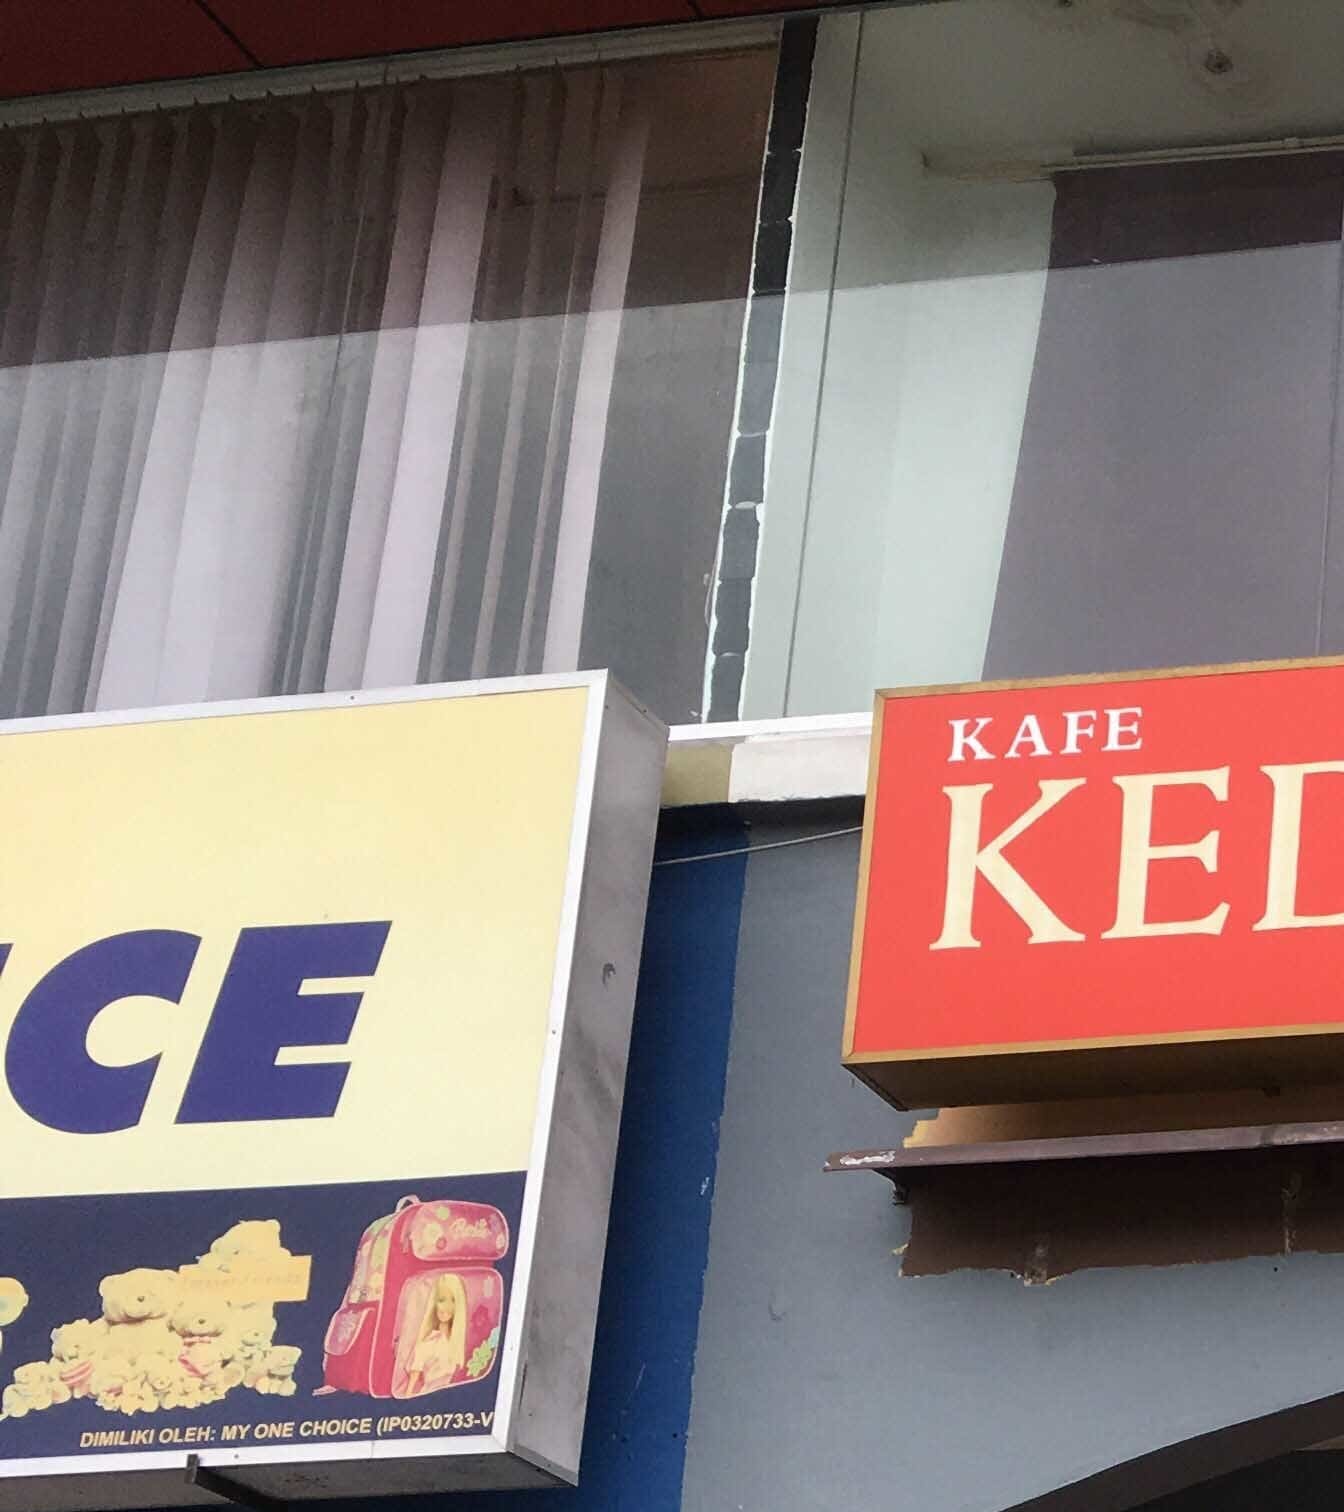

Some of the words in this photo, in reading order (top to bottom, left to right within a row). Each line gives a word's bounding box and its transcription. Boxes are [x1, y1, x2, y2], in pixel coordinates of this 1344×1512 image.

[949, 706, 1144, 763] KAFE
[0, 921, 392, 1134] CE
[80, 1429, 155, 1448] DIMILIKI
[158, 1427, 217, 1445] OLEH:
[221, 1425, 251, 1442] MY
[254, 1422, 295, 1439] ONE
[299, 1417, 373, 1438] CHOICE
[376, 1411, 494, 1437] (IP0320733-V
